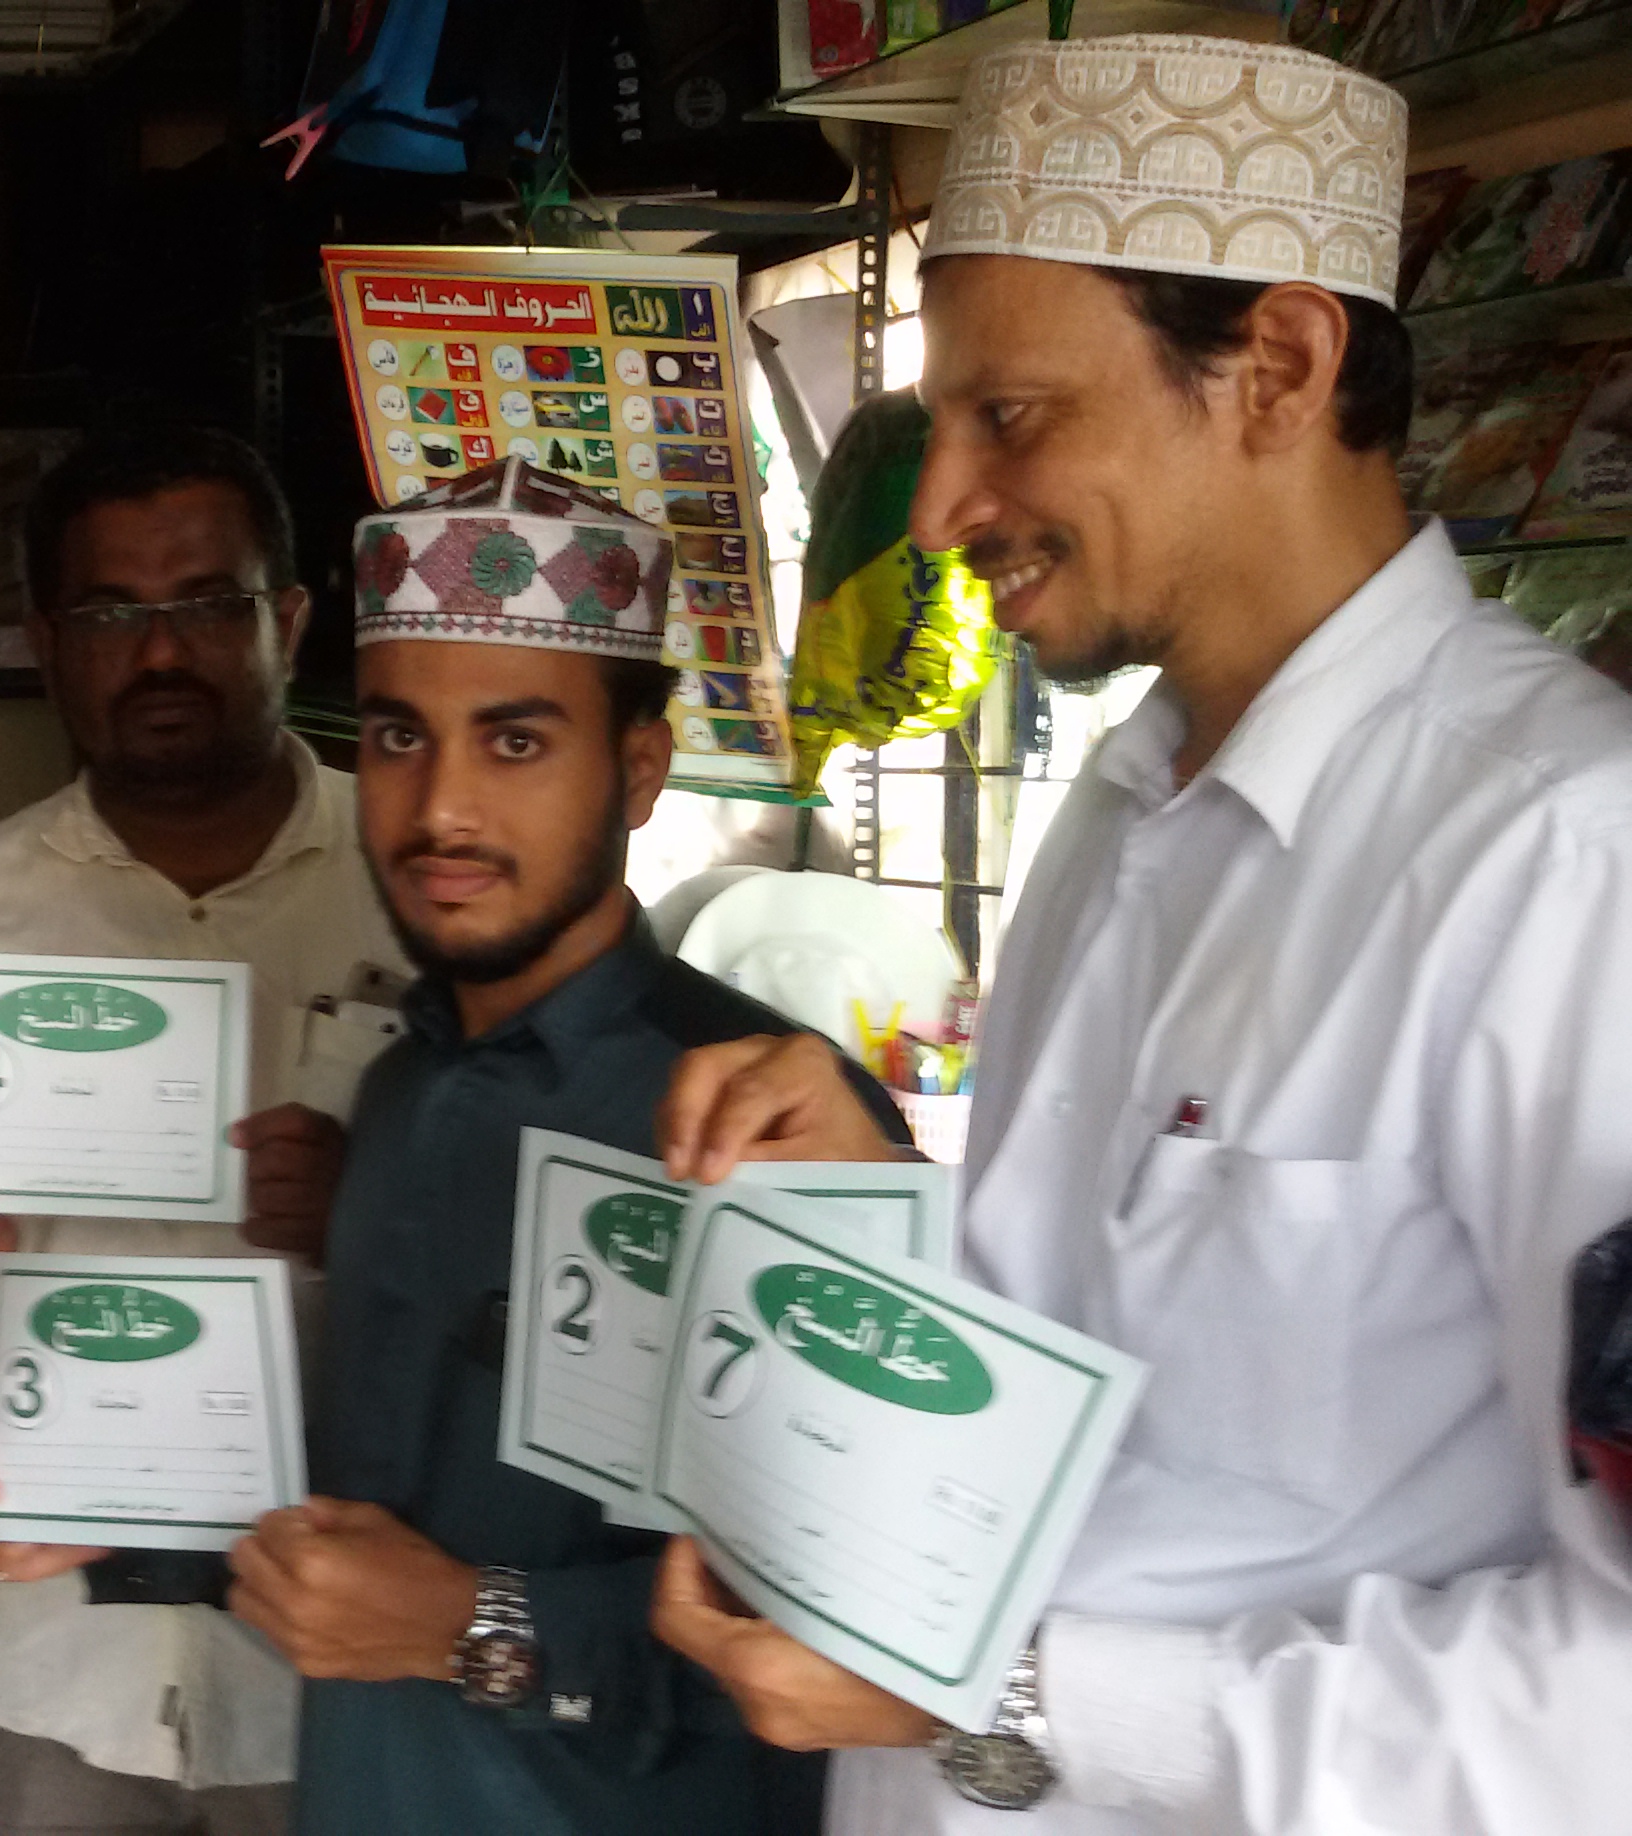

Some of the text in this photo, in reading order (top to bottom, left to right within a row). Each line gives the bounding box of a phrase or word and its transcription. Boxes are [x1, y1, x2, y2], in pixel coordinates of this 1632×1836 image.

[363, 282, 593, 328] الحروف الهجائية
[612, 288, 668, 333] الله
[447, 344, 476, 368] ف
[552, 1264, 592, 1341] 2
[700, 1321, 756, 1399] 7
[7, 1357, 42, 1419] 3
